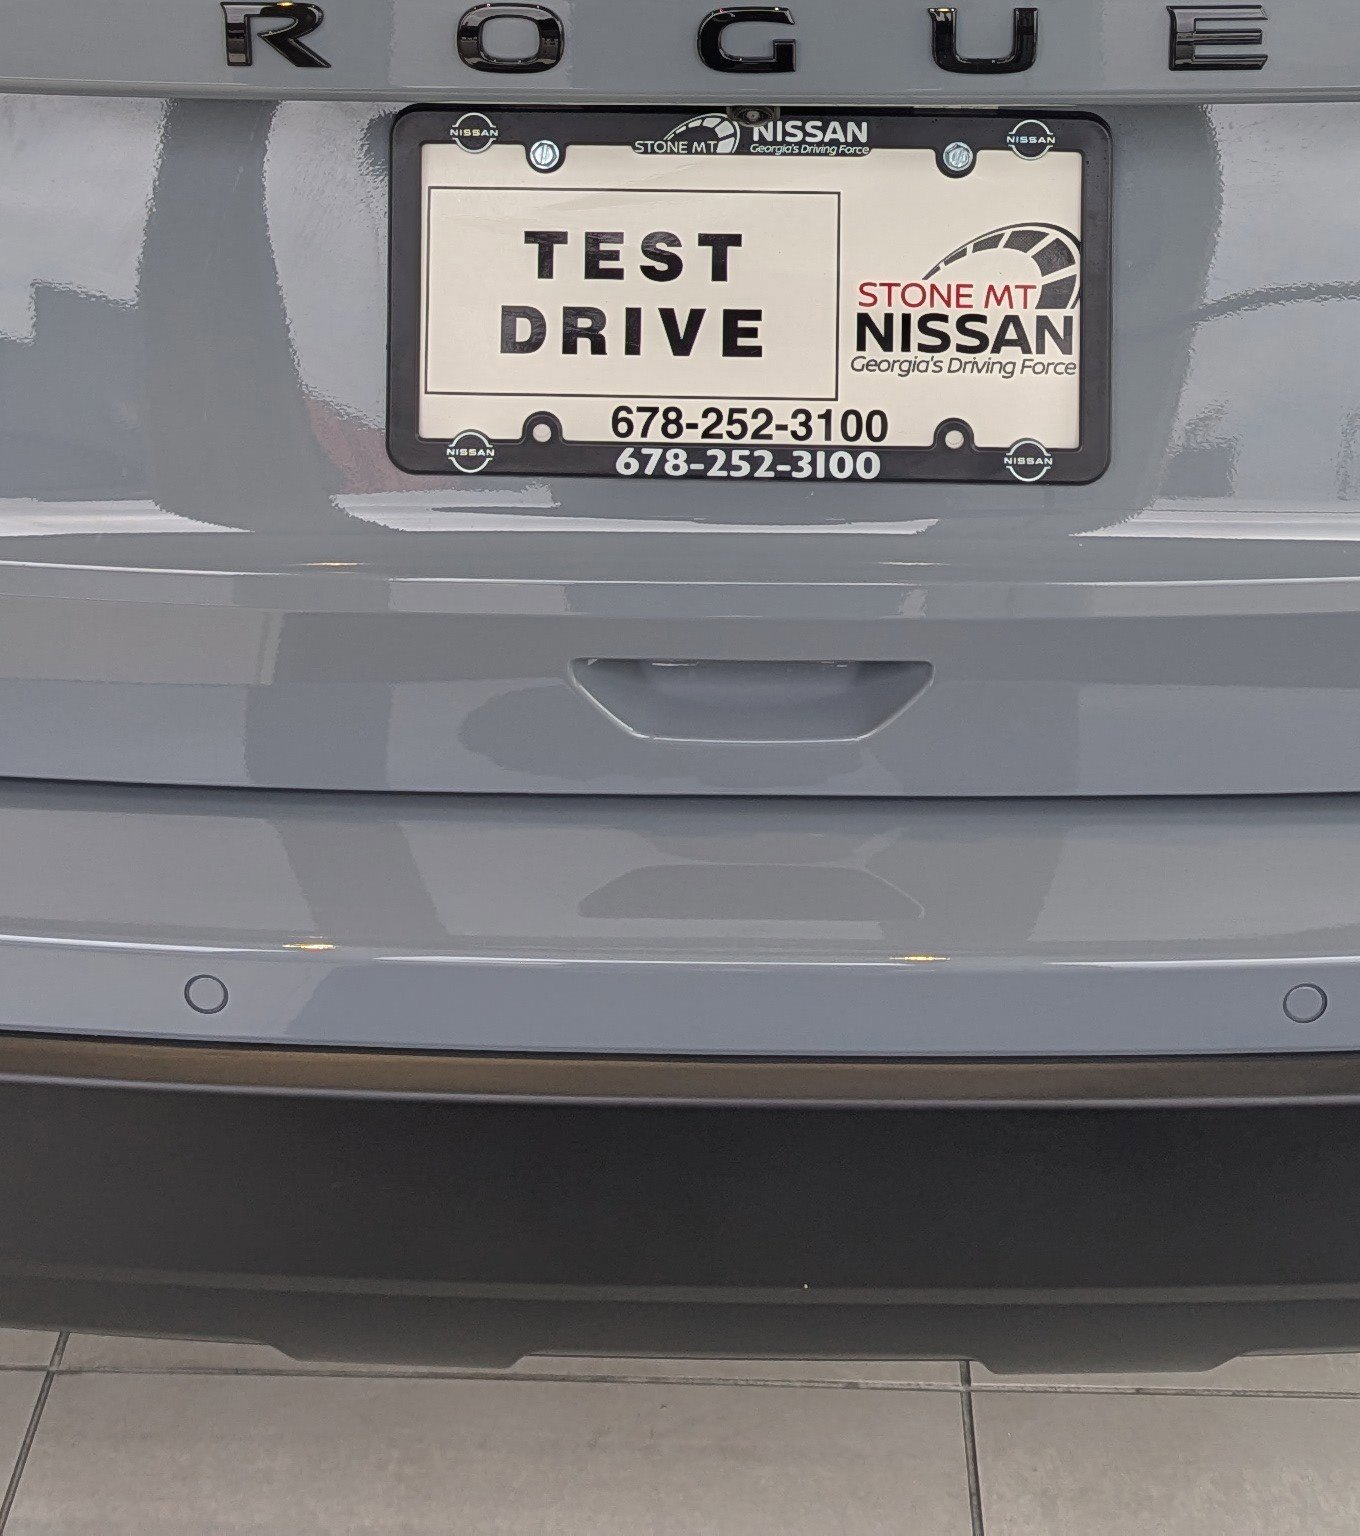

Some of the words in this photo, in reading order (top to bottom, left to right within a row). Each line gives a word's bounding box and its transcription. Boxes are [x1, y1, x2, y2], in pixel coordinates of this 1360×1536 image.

[220, 1, 1268, 75] ROGUE
[449, 128, 499, 137] NISSAN
[752, 120, 868, 143] NISSAN
[1006, 135, 1056, 144] NISSAN
[634, 140, 688, 154] STONE
[692, 140, 718, 154] MT
[750, 142, 799, 156] Georgia's
[800, 143, 837, 156] Driving
[838, 144, 871, 155] Force
[524, 230, 743, 282] TEST
[858, 281, 974, 309] STONE
[983, 284, 1037, 310] MT
[500, 305, 763, 358] DRIVE
[856, 312, 1074, 356] NISSAN
[850, 355, 944, 378] Georgia's
[947, 357, 1016, 379] Driving
[1020, 358, 1078, 376] Force
[611, 405, 889, 443] 678-252-3100
[446, 448, 496, 457] NISSAN
[615, 447, 882, 480] 678-252-3100
[1003, 456, 1054, 466] NISSAN
